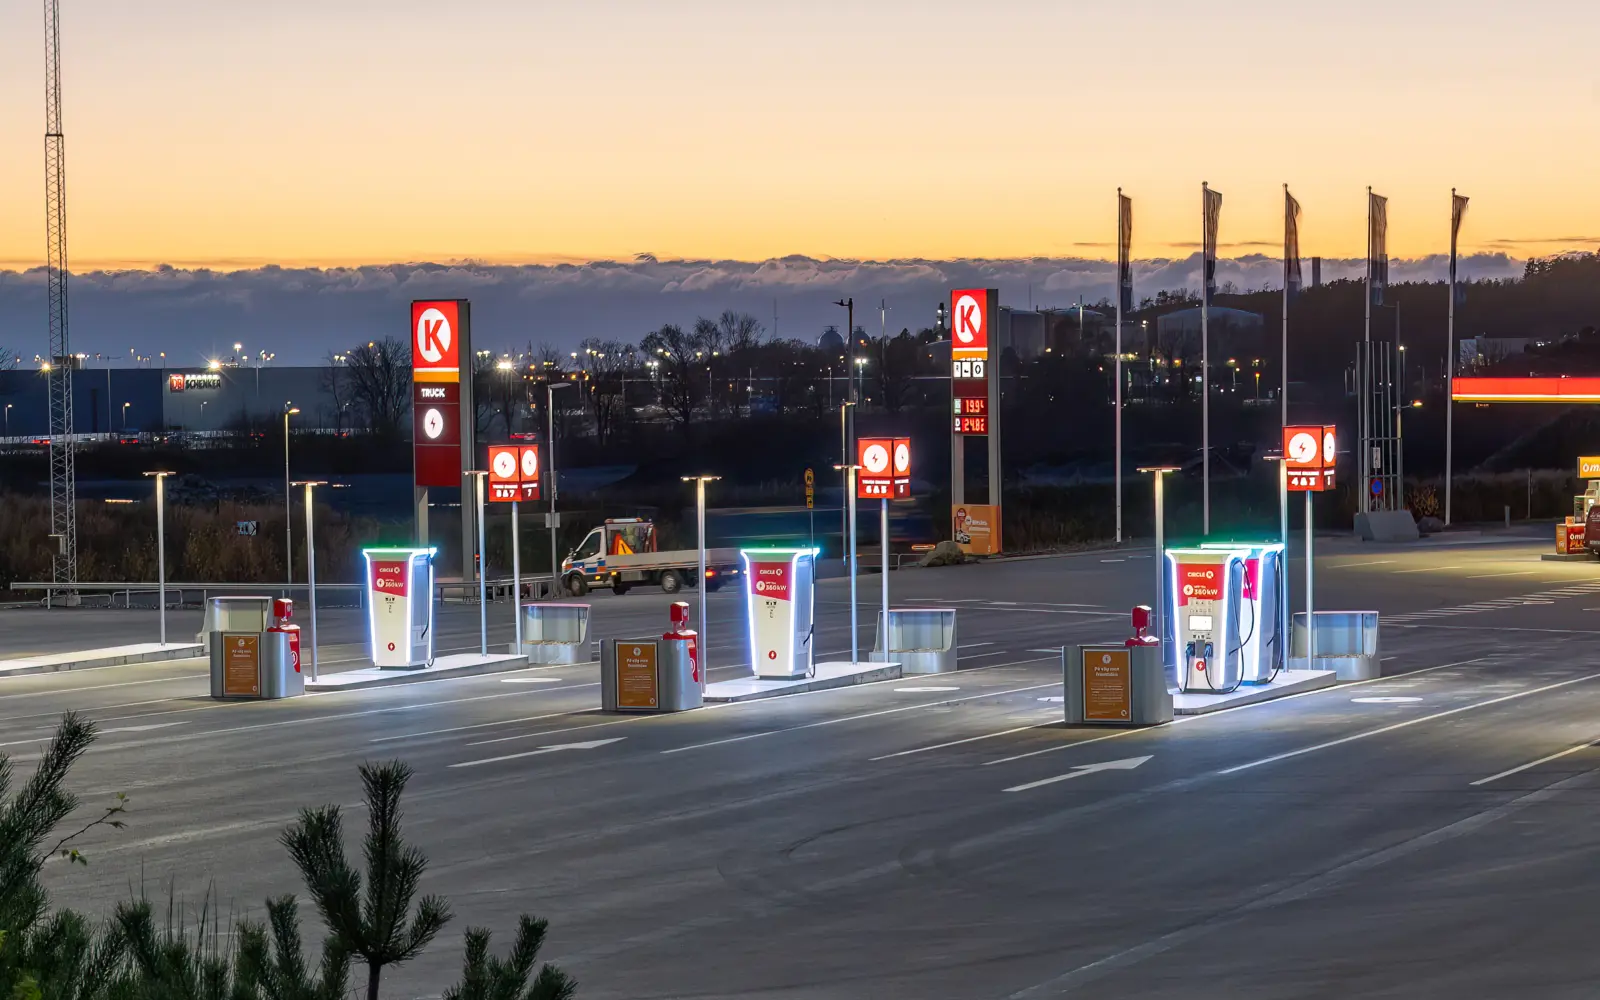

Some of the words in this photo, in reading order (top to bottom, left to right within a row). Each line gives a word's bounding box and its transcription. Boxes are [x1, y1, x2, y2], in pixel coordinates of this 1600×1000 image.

[423, 318, 448, 360] K
[959, 303, 979, 341] K
[421, 388, 446, 398] TRUCK
